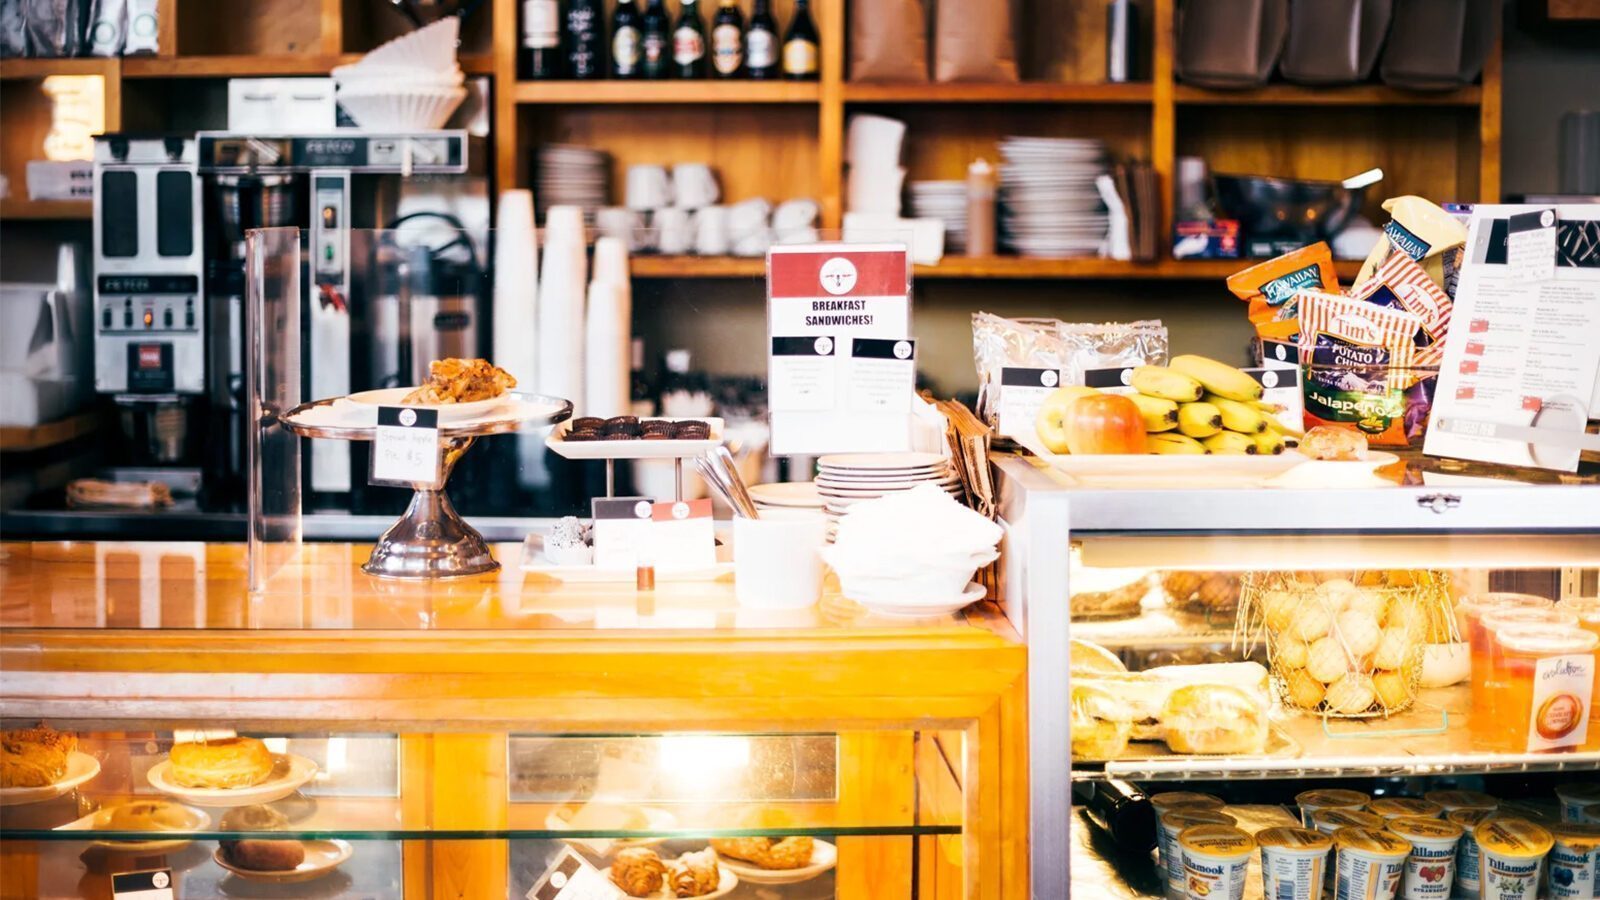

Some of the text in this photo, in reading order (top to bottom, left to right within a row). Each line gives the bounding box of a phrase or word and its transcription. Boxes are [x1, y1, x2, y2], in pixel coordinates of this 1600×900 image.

[812, 300, 867, 311] BREAKFAST
[1404, 286, 1436, 325] Tim's
[805, 315, 874, 326] SANDWICHES!
[1334, 317, 1376, 343] Tim's
[1331, 343, 1373, 364] POTATO
[1487, 856, 1537, 873] Tillamook
